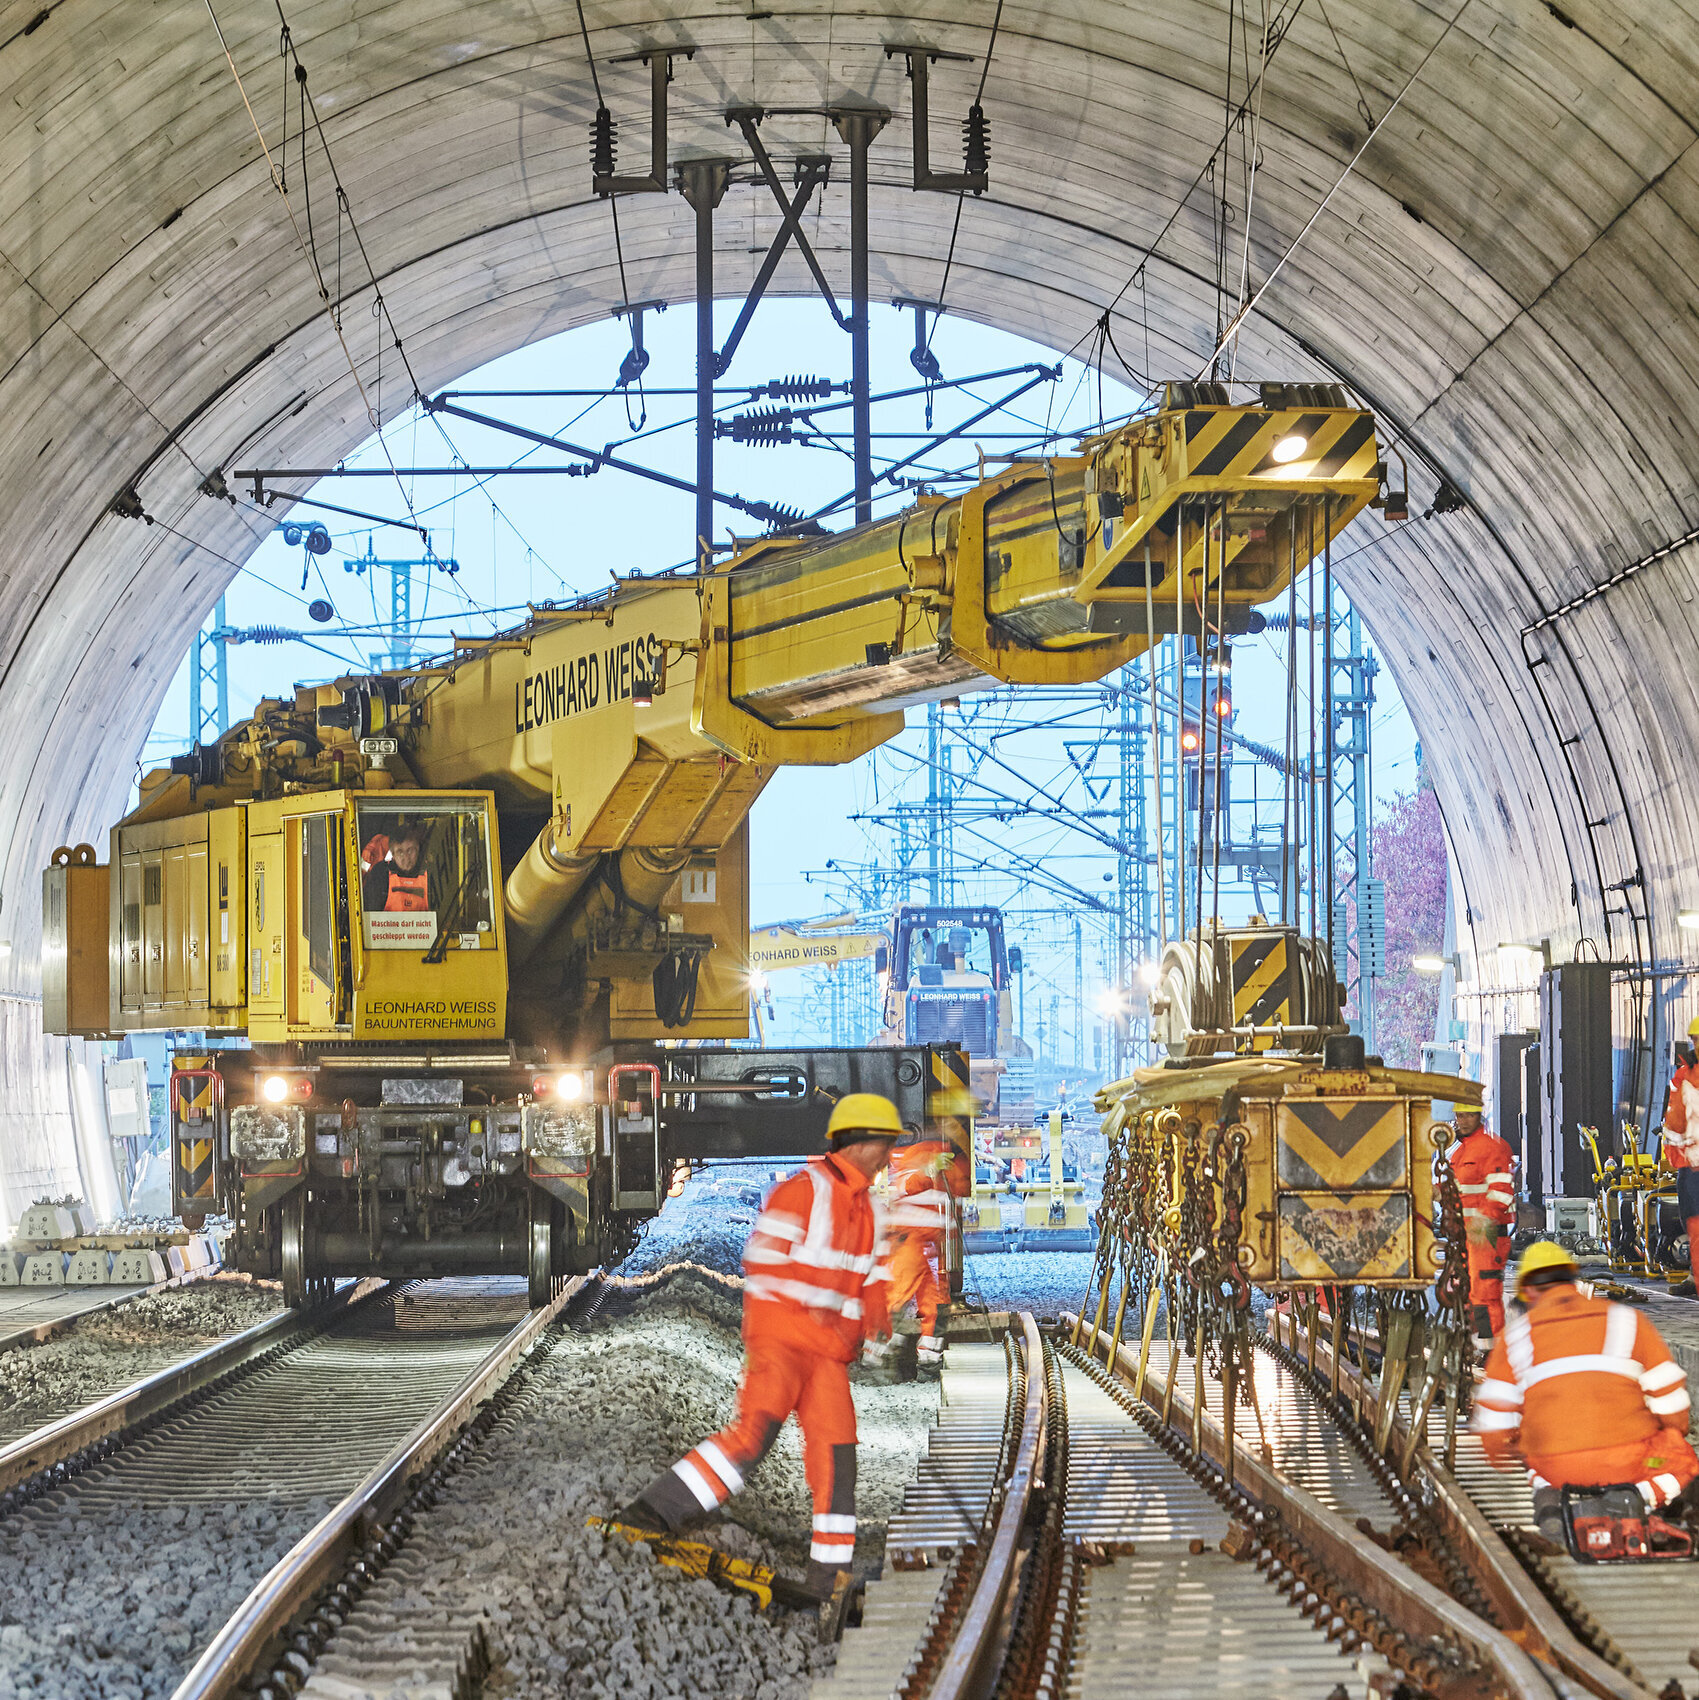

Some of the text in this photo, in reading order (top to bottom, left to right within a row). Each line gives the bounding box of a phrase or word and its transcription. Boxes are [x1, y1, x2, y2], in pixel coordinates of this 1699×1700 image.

[516, 632, 658, 734] LEONHARD WEISS
[936, 919, 963, 927] 502548
[372, 932, 430, 940] geschleppt werden
[749, 945, 837, 962] EONHARD WEISS
[920, 992, 981, 1001] LEONHARD WEISS
[365, 1001, 496, 1014] LEONHARD WEISS
[364, 1018, 496, 1029] BAUUNTERNEHMUNG
